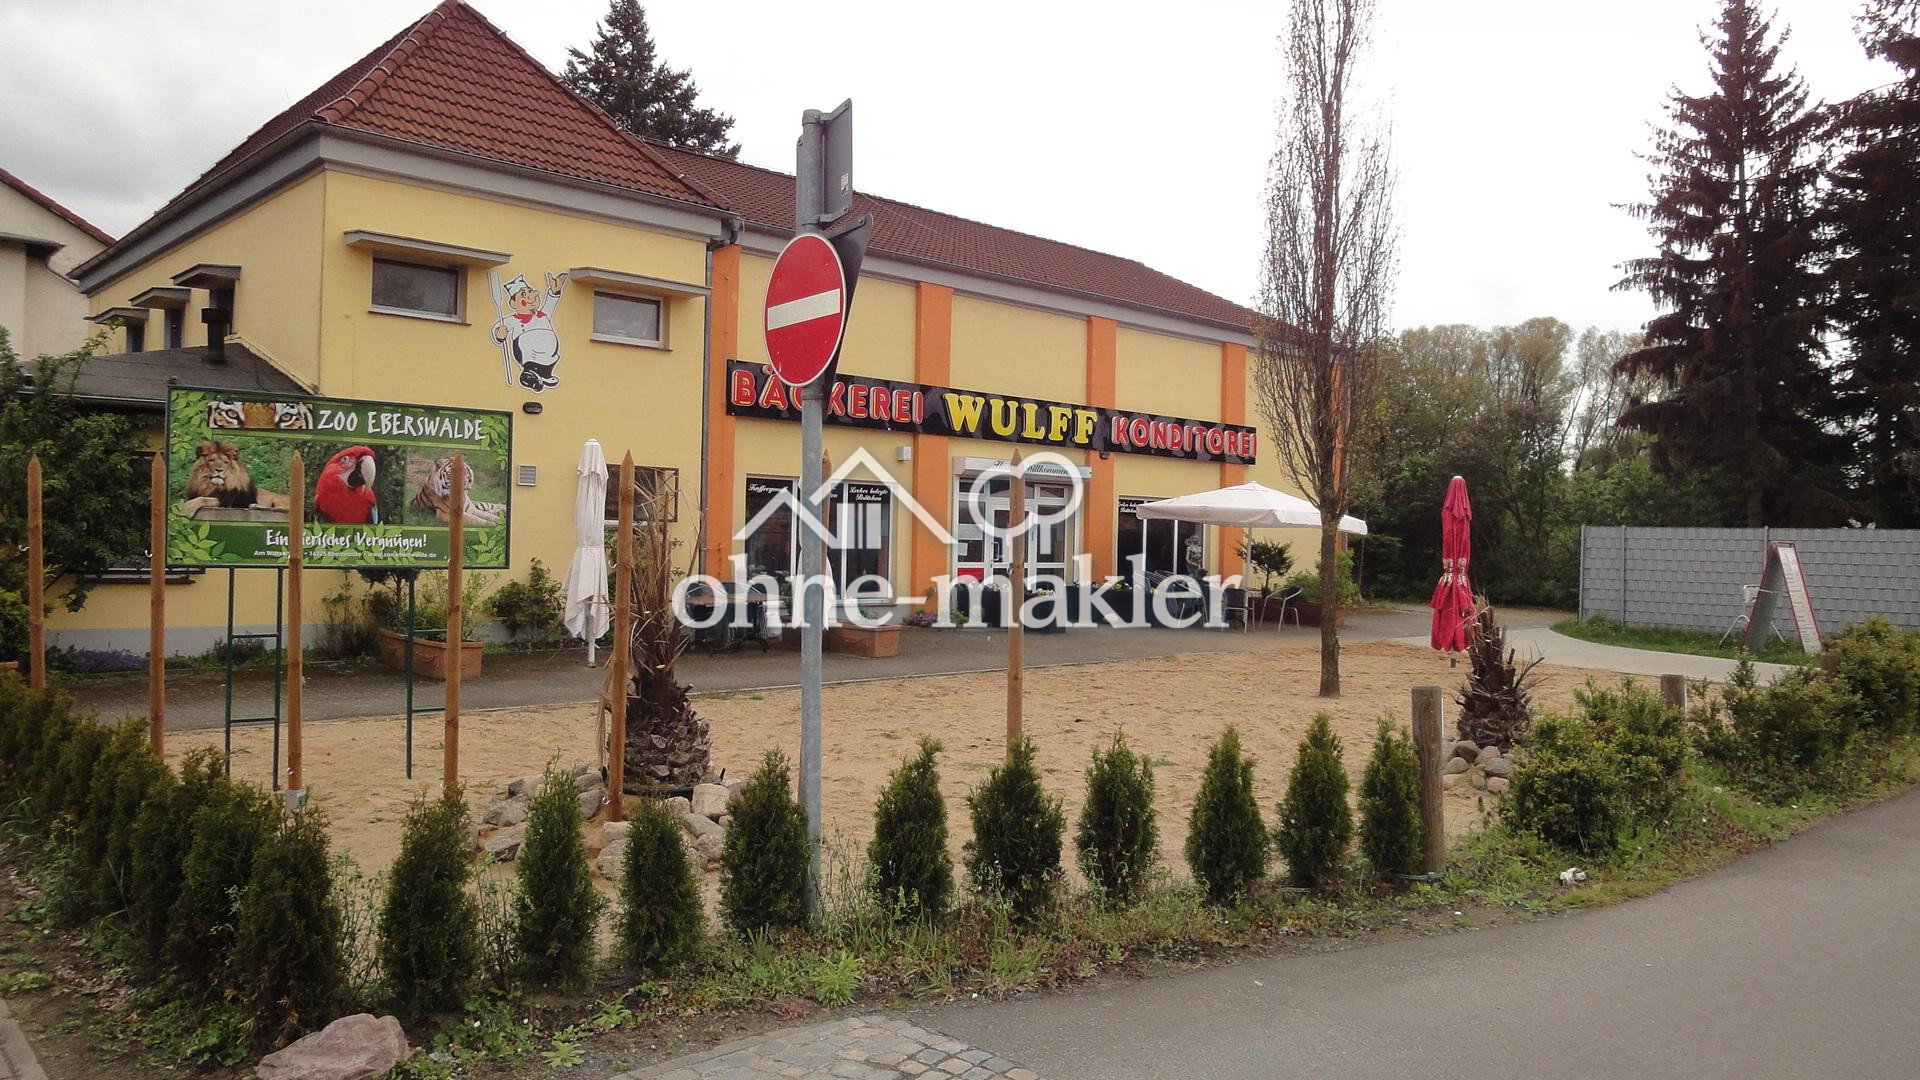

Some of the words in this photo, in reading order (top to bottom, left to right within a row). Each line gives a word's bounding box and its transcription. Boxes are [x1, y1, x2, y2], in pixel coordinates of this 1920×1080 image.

[318, 411, 358, 431] ZOO
[367, 411, 486, 440] EBERSWALDE
[943, 393, 1098, 444] WULFF
[1111, 416, 1258, 458] KONDITOREI
[266, 530, 289, 546] Ein
[302, 531, 351, 548] ierisches
[356, 532, 427, 551] Vergnügen!
